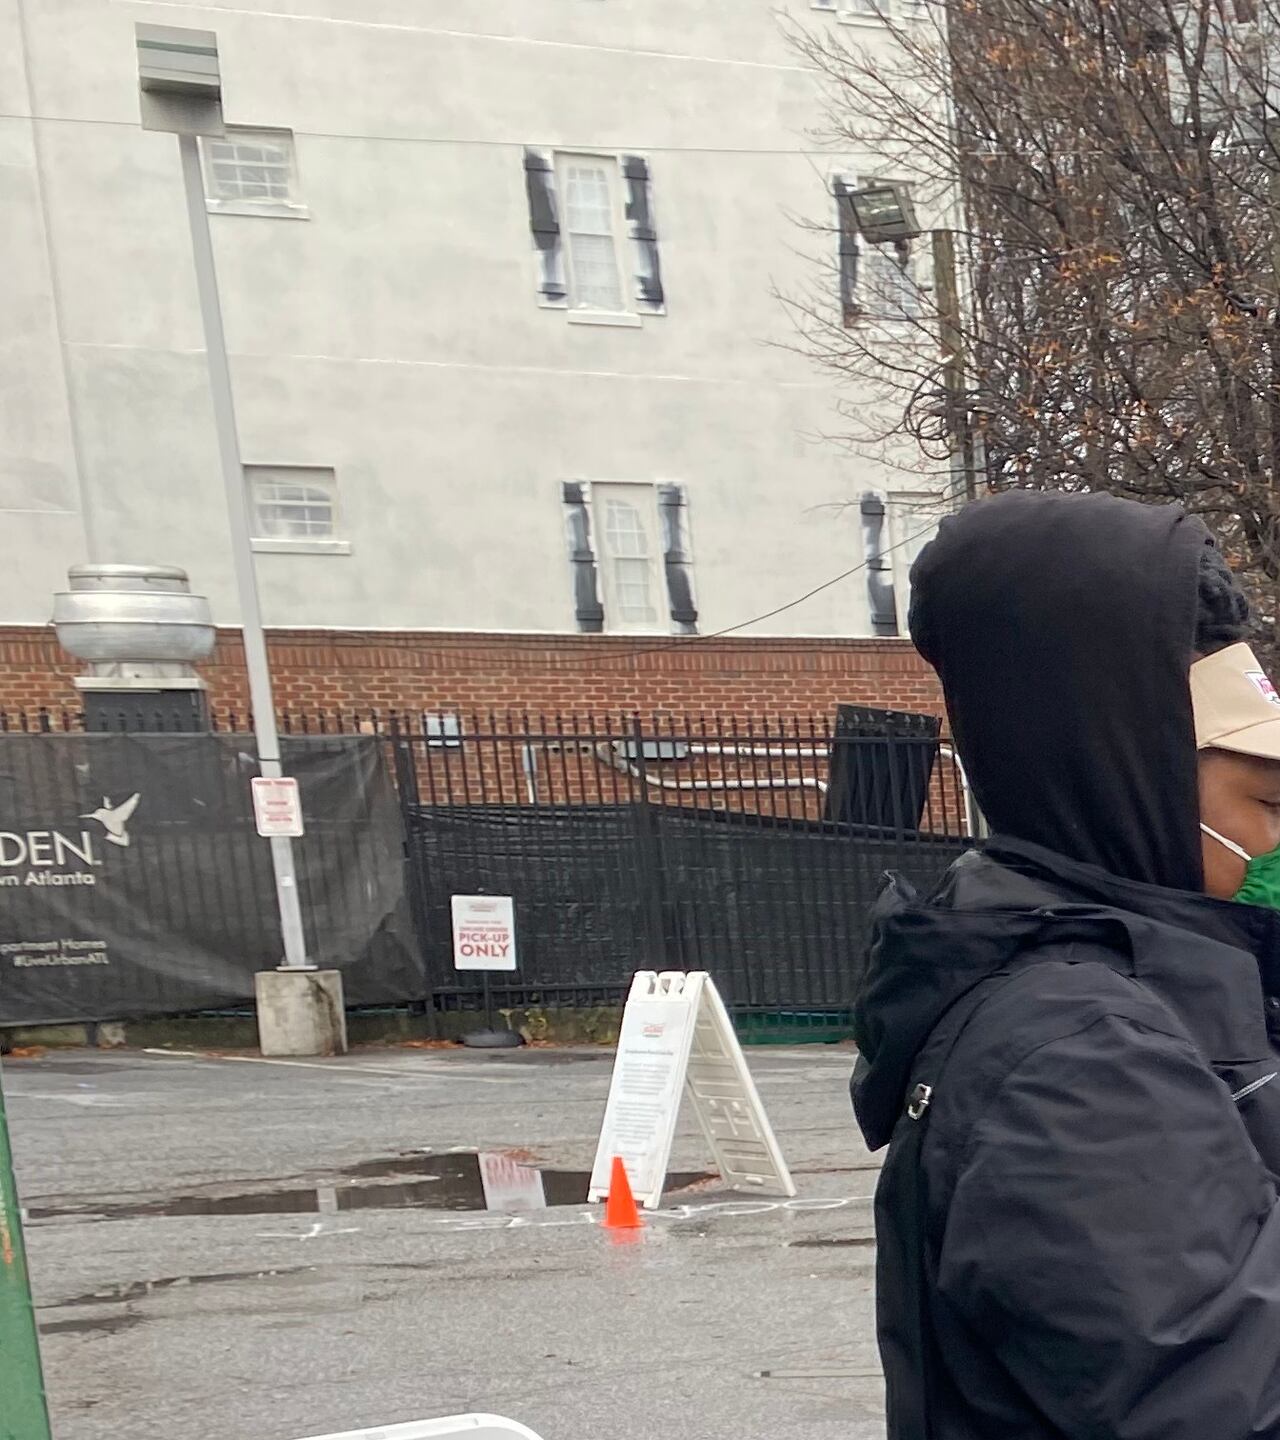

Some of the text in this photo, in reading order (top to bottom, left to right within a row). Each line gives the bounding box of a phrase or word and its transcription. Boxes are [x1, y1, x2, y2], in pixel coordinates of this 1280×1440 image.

[24, 871, 96, 886] Atlanta
[59, 938, 107, 950] Homes
[459, 932, 509, 943] PICK-UP
[460, 944, 509, 958] ONLY
